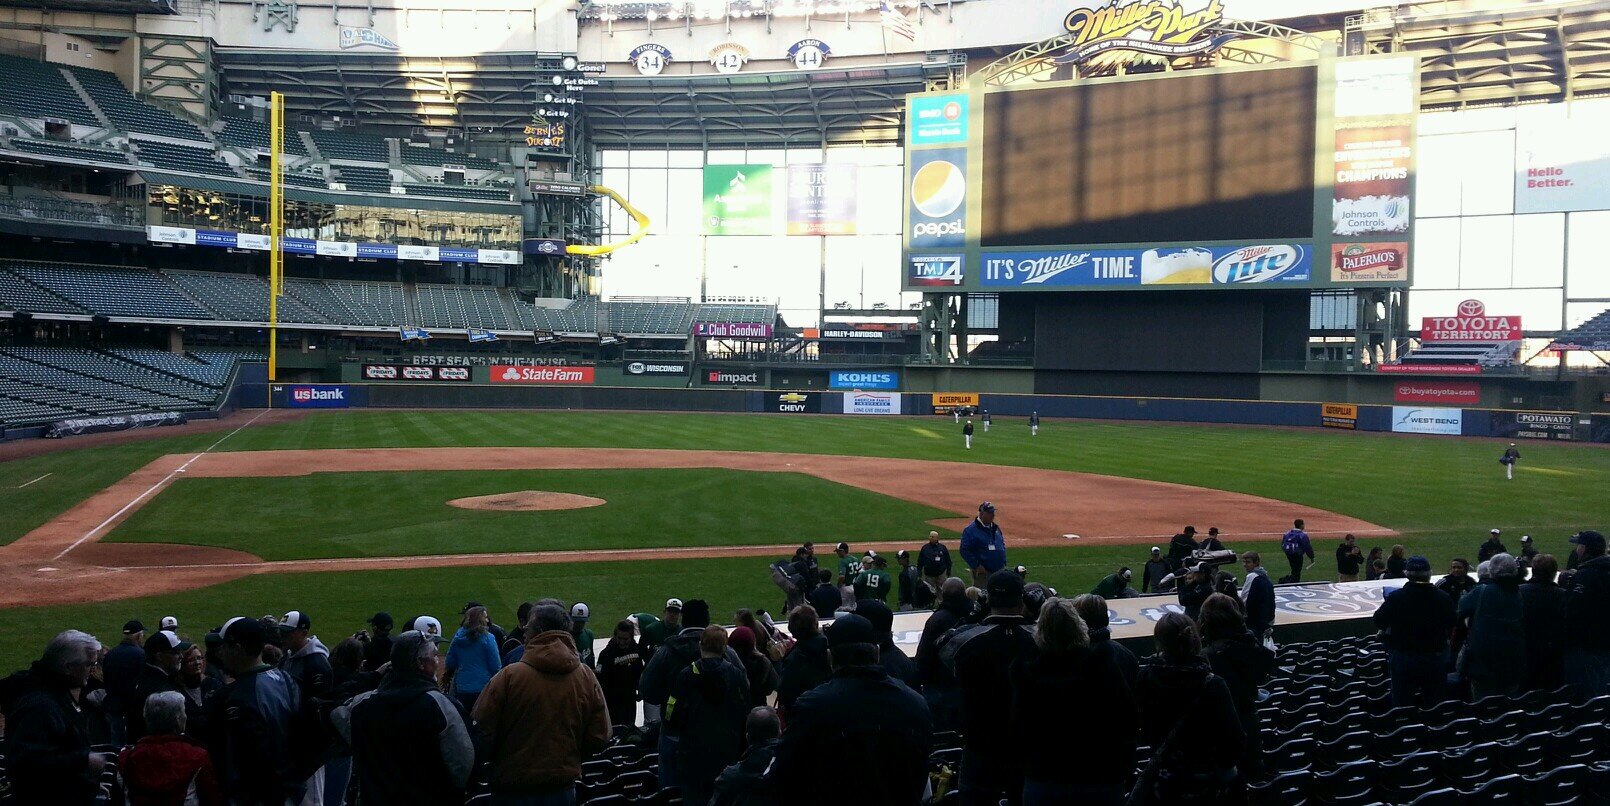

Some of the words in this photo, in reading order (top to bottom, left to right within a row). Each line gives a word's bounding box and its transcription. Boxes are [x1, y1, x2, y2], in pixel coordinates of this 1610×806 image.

[1065, 2, 1161, 46] Miller
[1142, 0, 1224, 42] Park
[636, 44, 665, 54] FINGERS
[713, 43, 745, 54] ROBINSON
[797, 40, 821, 48] AARON
[1079, 45, 1099, 57] HOME
[1128, 40, 1173, 53] MILWAUKEE
[1173, 40, 1211, 53] BREWERS
[641, 56, 659, 69] 34
[719, 55, 738, 68] 42
[798, 52, 818, 65] 44
[577, 64, 606, 72] Gone!
[526, 137, 564, 147] DUGOUT
[1337, 167, 1408, 182] CHAMPIONS
[1528, 167, 1564, 177] Hello
[1528, 179, 1574, 188] Better.
[1342, 211, 1378, 219] Johnson
[914, 219, 965, 238] pepsi
[1348, 219, 1385, 227] Controls
[1237, 246, 1273, 261] Miller
[1343, 252, 1395, 269] PALERMO'S
[987, 258, 1015, 280] IT'S
[1018, 253, 1091, 284] Miller
[1092, 257, 1139, 279] TIME.
[1226, 253, 1287, 283] Lite
[1376, 271, 1398, 279] Perfect
[1433, 317, 1510, 330] TOYOTA
[709, 324, 728, 336] Club
[730, 324, 766, 336] Goodwill
[1432, 330, 1511, 339] TERRITORY
[413, 356, 444, 366] BEST
[446, 356, 486, 366] SEATS
[718, 371, 757, 383] impact
[838, 374, 891, 382] KOHL'S
[1411, 388, 1475, 397] buyatoyota.com
[779, 404, 806, 412] CHEVY
[1325, 406, 1352, 415] CATERPILLAR
[866, 573, 880, 588] 19
